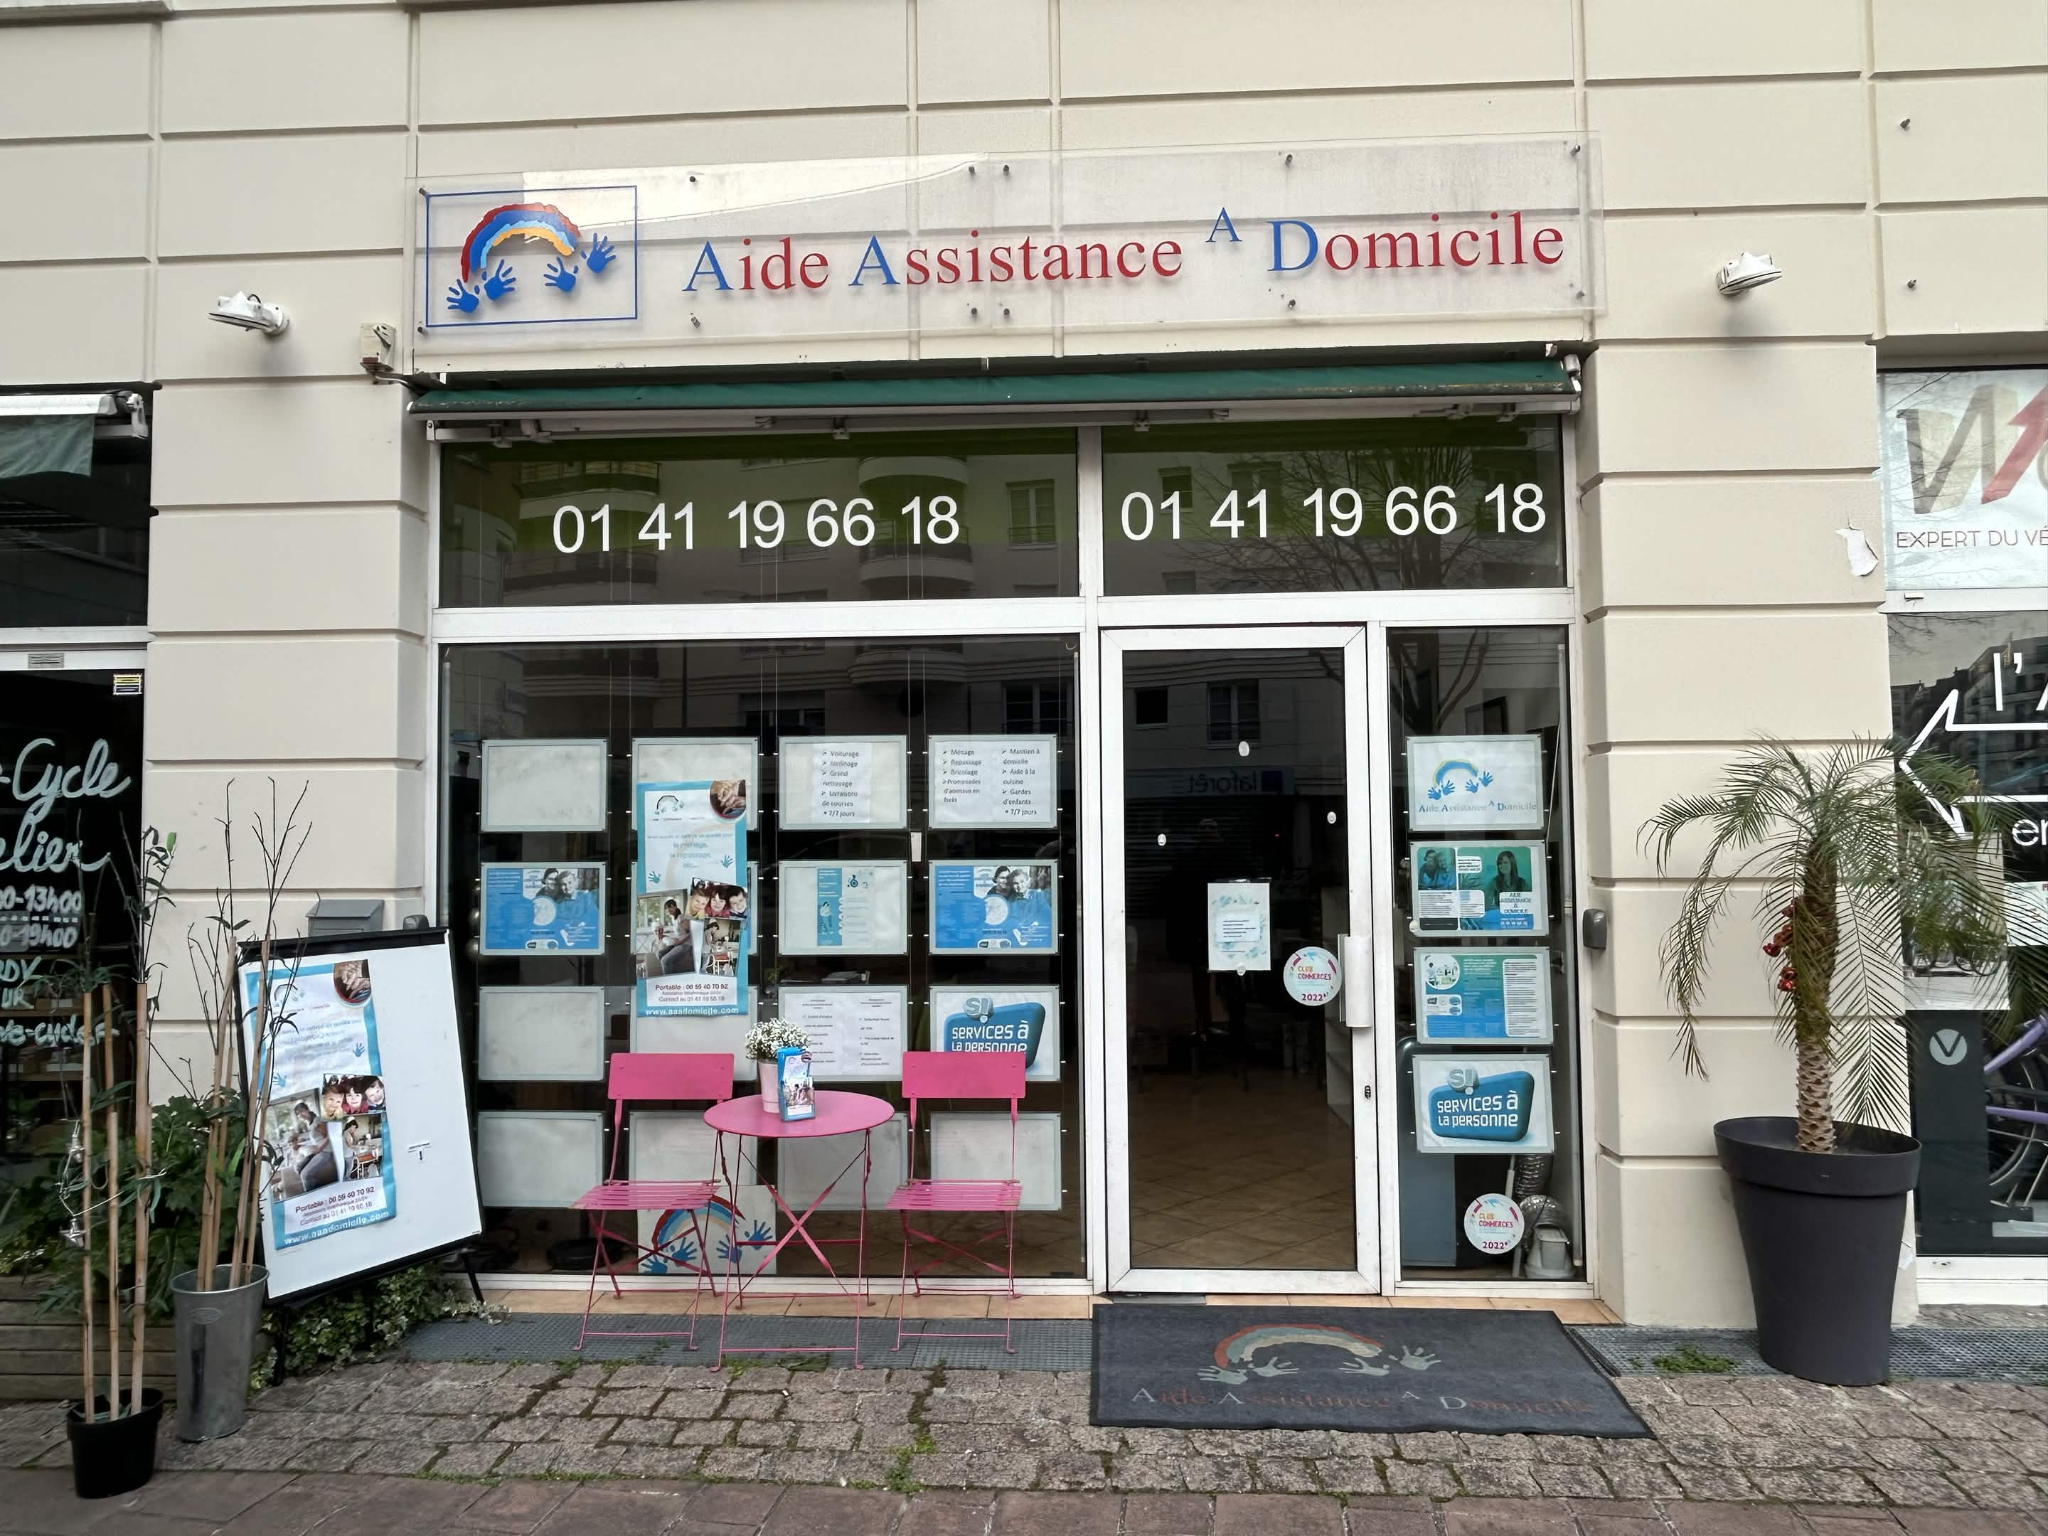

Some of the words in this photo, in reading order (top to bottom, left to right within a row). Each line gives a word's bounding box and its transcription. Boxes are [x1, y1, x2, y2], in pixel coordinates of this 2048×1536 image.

[684, 237, 829, 292] Aide
[848, 230, 1182, 287] Assistance
[1206, 207, 1242, 243] A
[1267, 211, 1564, 272] Domicile
[552, 503, 610, 554] 01
[638, 501, 694, 551] 41
[727, 499, 785, 549] 19
[806, 497, 876, 548] 66
[901, 495, 960, 545] 18
[1121, 490, 1181, 541] 01
[1209, 488, 1267, 539] 41
[1303, 487, 1363, 538] 19
[1385, 485, 1458, 536] 66
[1484, 483, 1546, 534] 18
[1896, 530, 1981, 548] EXPERT
[1988, 529, 2018, 546] DU
